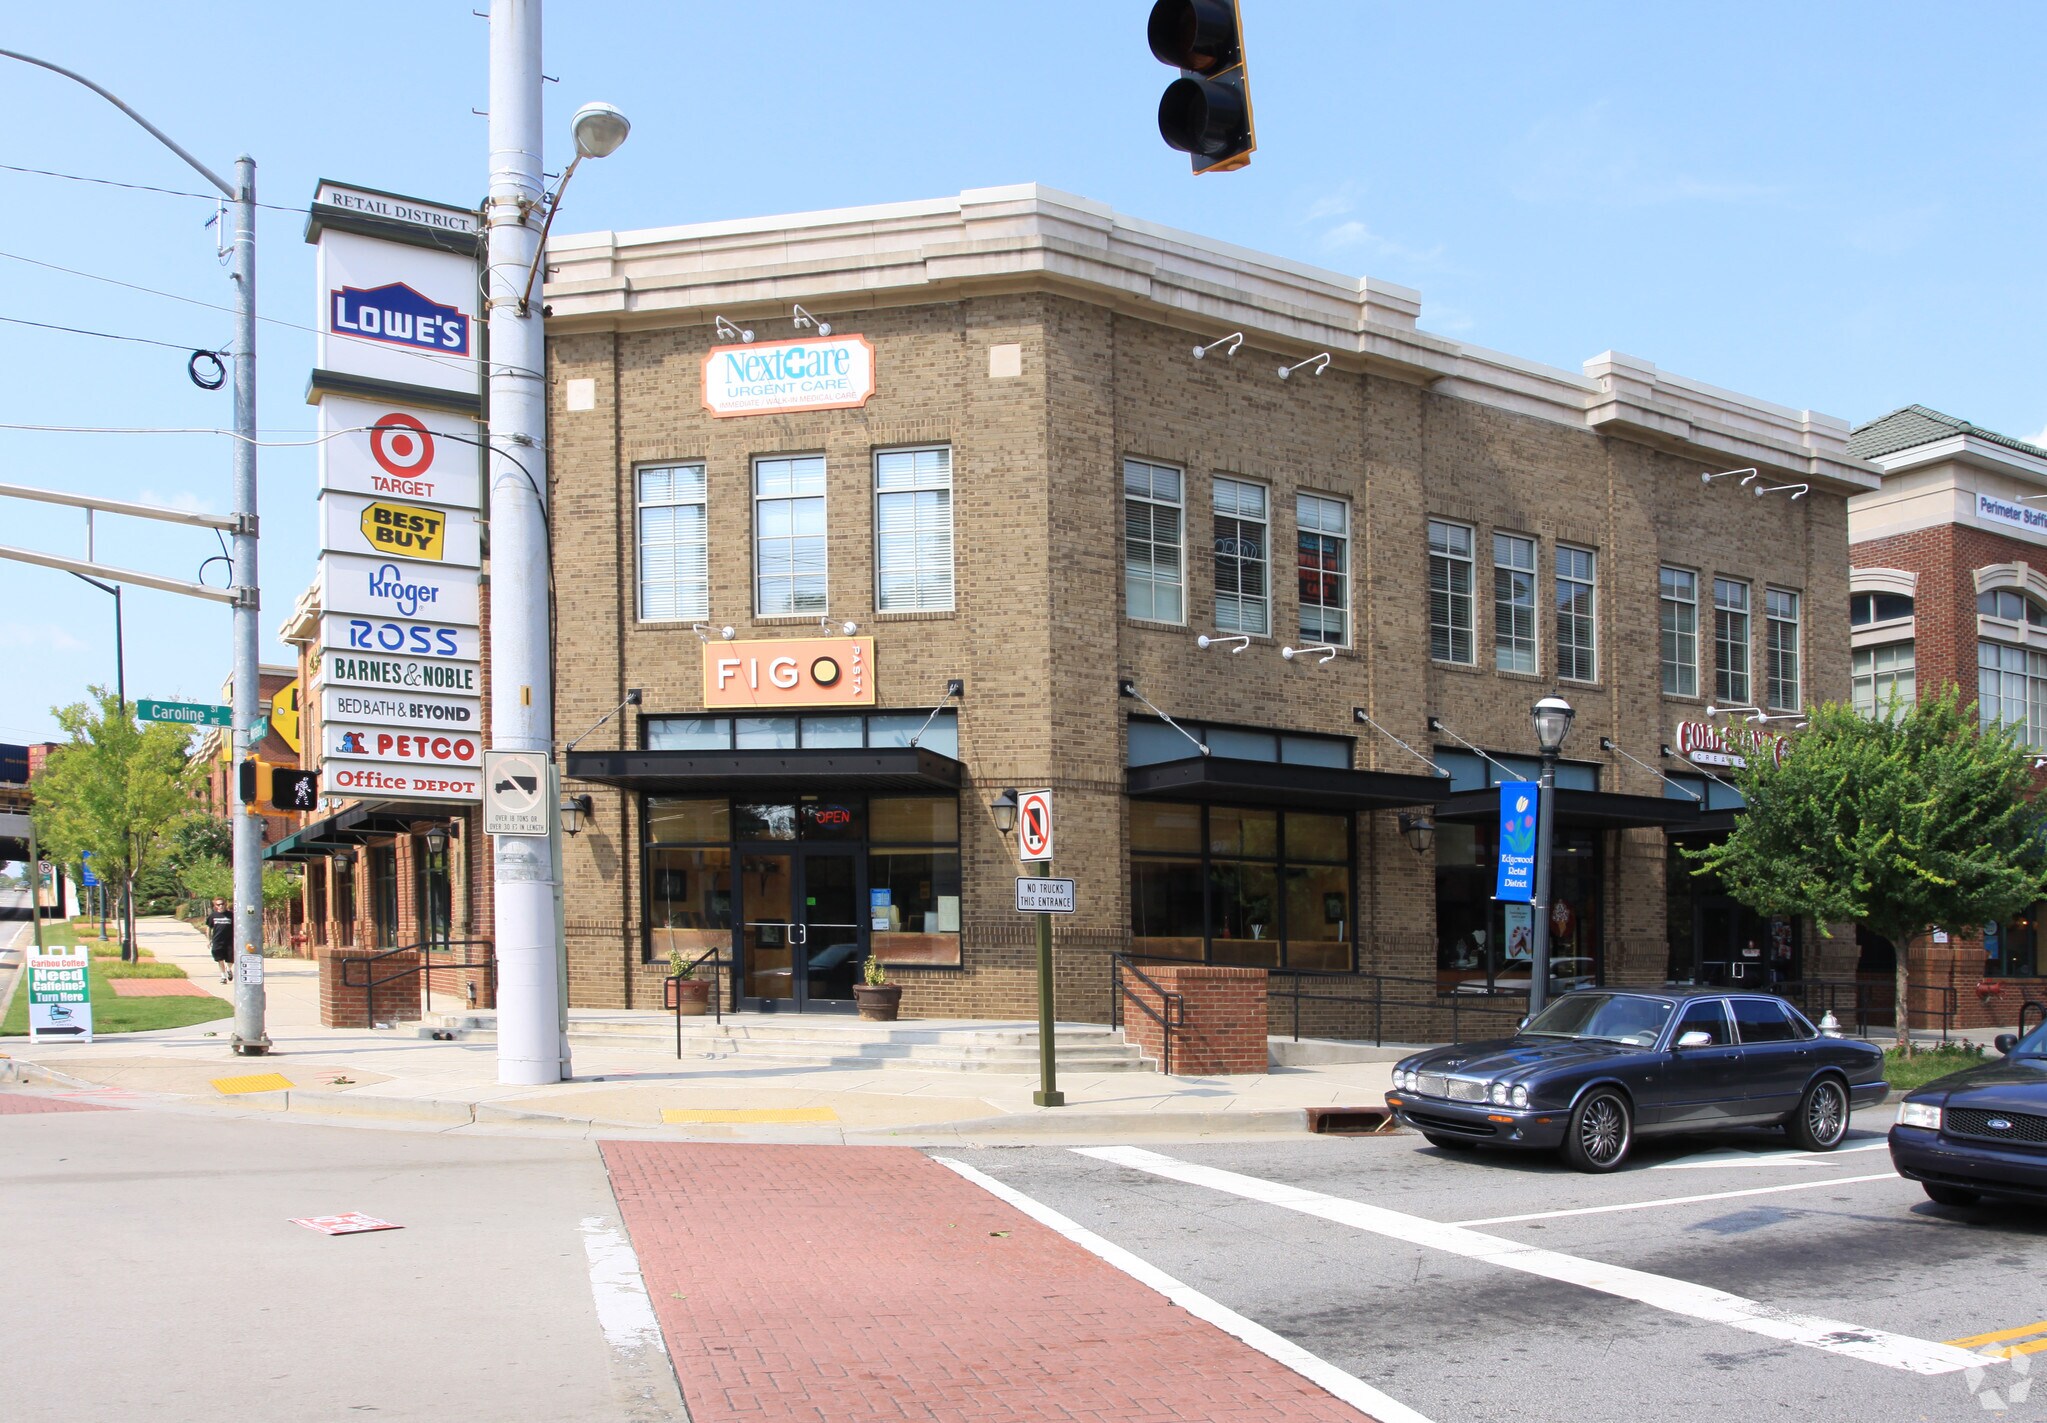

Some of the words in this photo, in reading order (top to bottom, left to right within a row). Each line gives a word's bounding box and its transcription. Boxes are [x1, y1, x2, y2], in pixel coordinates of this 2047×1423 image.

[332, 192, 391, 215] RETAIL
[394, 205, 469, 231] DISTRICT
[336, 296, 461, 348] LOWE'S
[725, 347, 850, 384] NextCare
[727, 382, 796, 398] URGENT
[801, 378, 847, 392] CARE
[719, 398, 759, 409] IMMEDIATE
[766, 395, 798, 405] WALK-IN
[799, 393, 833, 403] MEDICAL
[835, 391, 857, 400] CARE
[371, 476, 434, 497] TARGET
[1980, 496, 2022, 520] Perimeter
[374, 507, 440, 535] BEST
[376, 526, 434, 551] BUY
[369, 564, 439, 616] Kroger
[350, 620, 458, 656] ROSS
[423, 665, 473, 690] NOBLE
[717, 655, 841, 689] FIGO
[852, 645, 862, 696] PASTA
[151, 704, 205, 722] Caroline
[211, 705, 219, 713] ST
[397, 702, 407, 717] &
[409, 706, 471, 722] BEYOND
[211, 717, 220, 725] NE
[377, 733, 475, 761] PETCO
[1677, 721, 1723, 754] COLD
[336, 770, 407, 790] Office
[413, 779, 475, 793] DEPOT
[495, 814, 507, 822] OVER
[531, 815, 537, 823] OR
[816, 810, 850, 824] OPEN
[1501, 854, 1534, 865] Edgewood
[1508, 866, 1527, 876] Retail
[1027, 883, 1036, 893] NO
[1040, 884, 1064, 894] TRUCKS
[1504, 878, 1527, 888] District
[1020, 896, 1035, 907] THIS
[1038, 897, 1071, 907] ENTRANCE
[31, 959, 60, 967] Caribou
[61, 959, 86, 967] Coffee
[34, 969, 84, 981] Need
[32, 980, 86, 991] Caffeine?
[35, 992, 59, 1002] Turn
[60, 992, 84, 1001] Here
